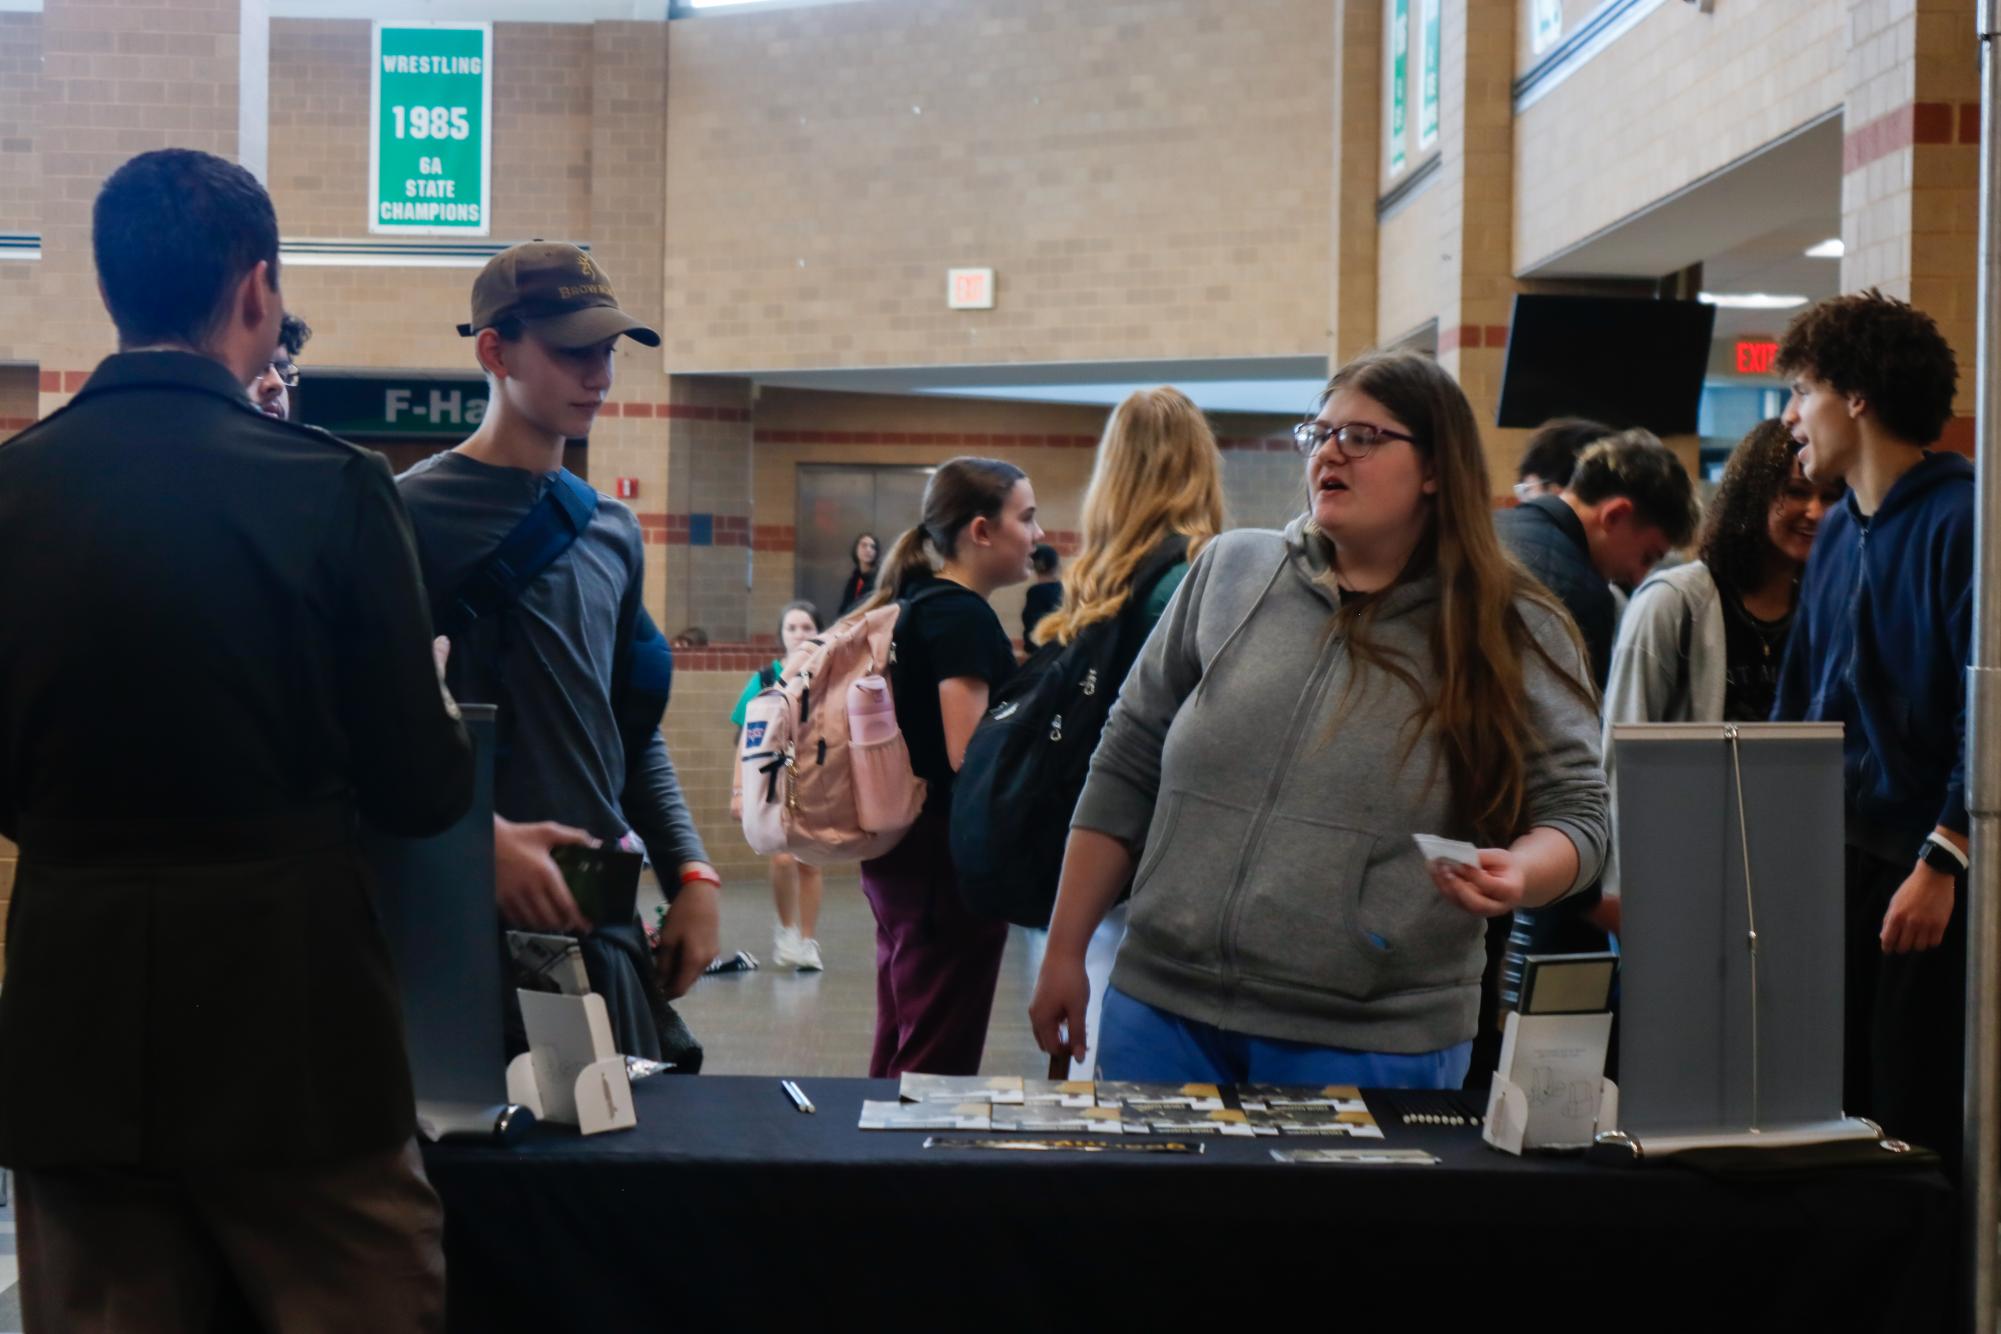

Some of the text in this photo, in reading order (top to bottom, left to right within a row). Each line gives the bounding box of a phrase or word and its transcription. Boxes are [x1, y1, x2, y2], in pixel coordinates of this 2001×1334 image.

[382, 55, 482, 75] WRESTLING
[392, 105, 470, 140] 1985
[419, 156, 443, 175] 6A
[405, 179, 456, 198] STATE
[380, 201, 480, 222] CHAMPIONS
[1736, 342, 1780, 373] EXIT
[385, 388, 489, 425] F-Ha
